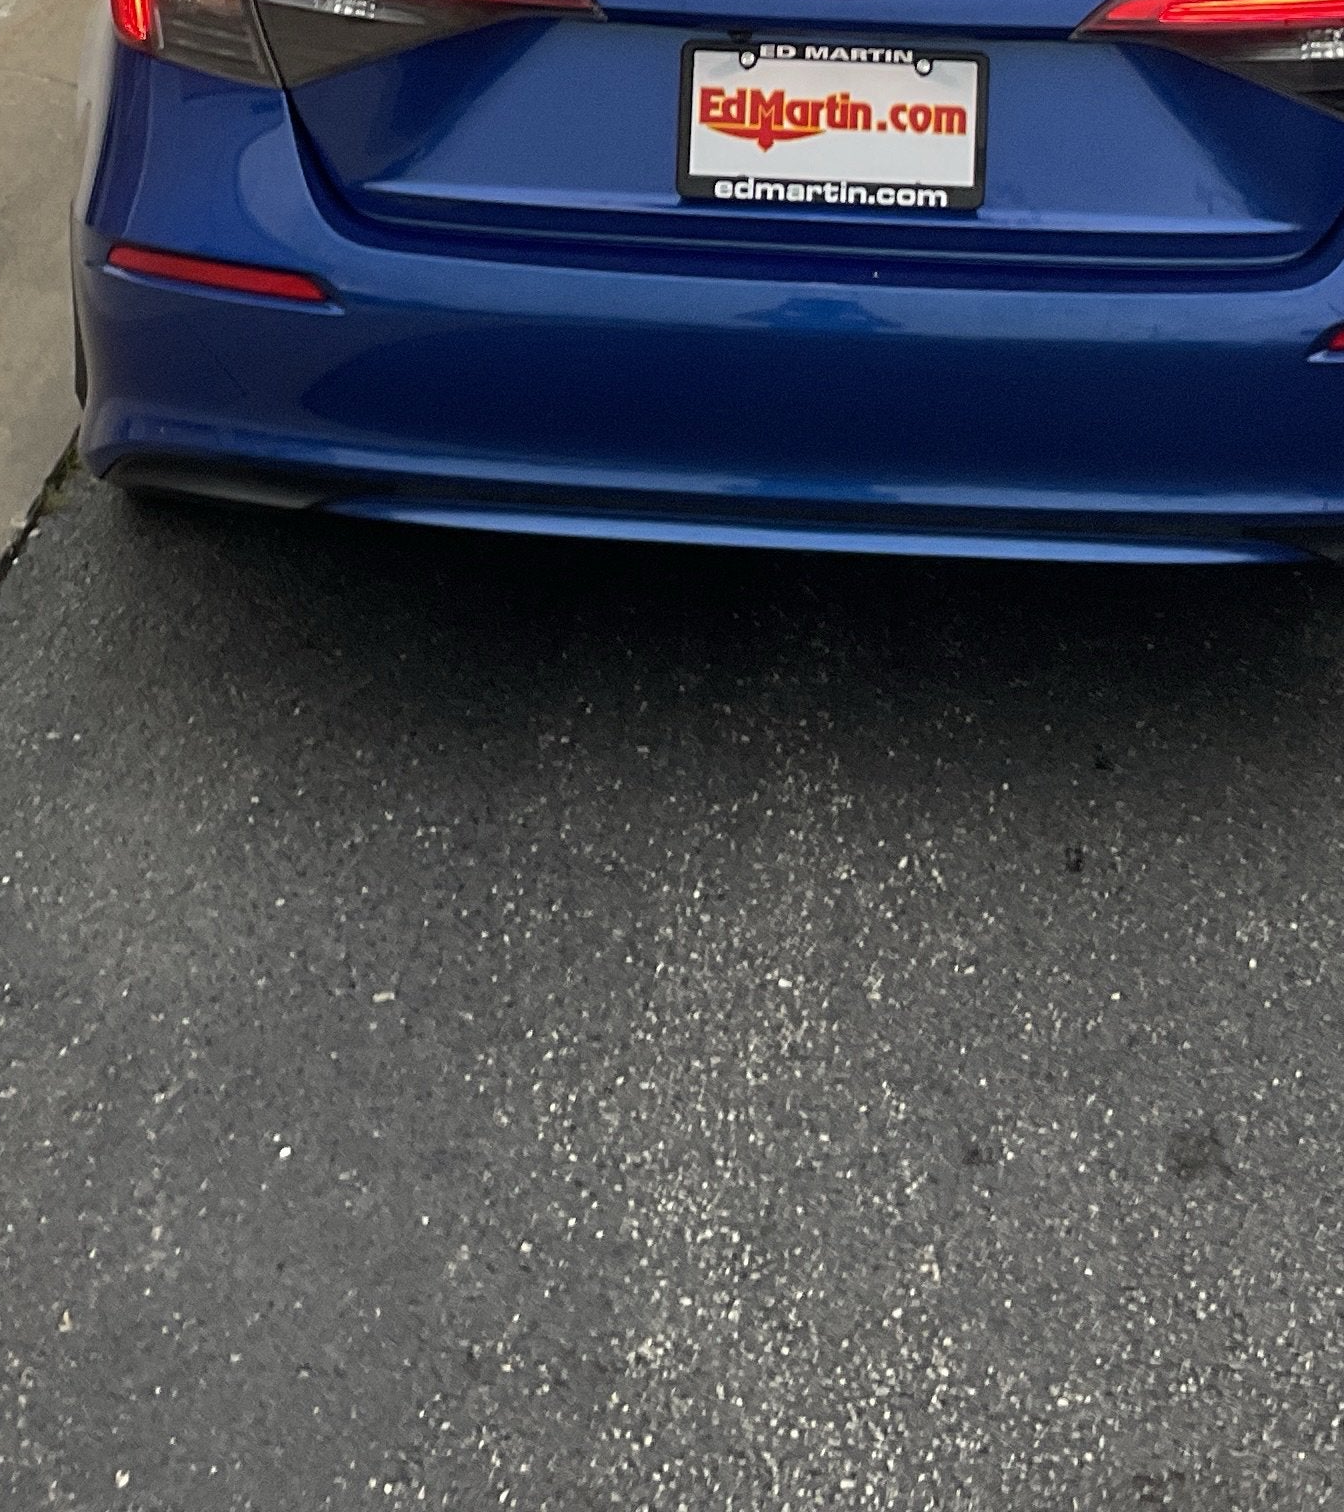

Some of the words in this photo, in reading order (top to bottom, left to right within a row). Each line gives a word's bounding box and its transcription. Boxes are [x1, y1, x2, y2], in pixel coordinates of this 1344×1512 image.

[760, 43, 797, 59] ED
[805, 45, 914, 64] MARTIN
[714, 177, 948, 208] edmartin.com
